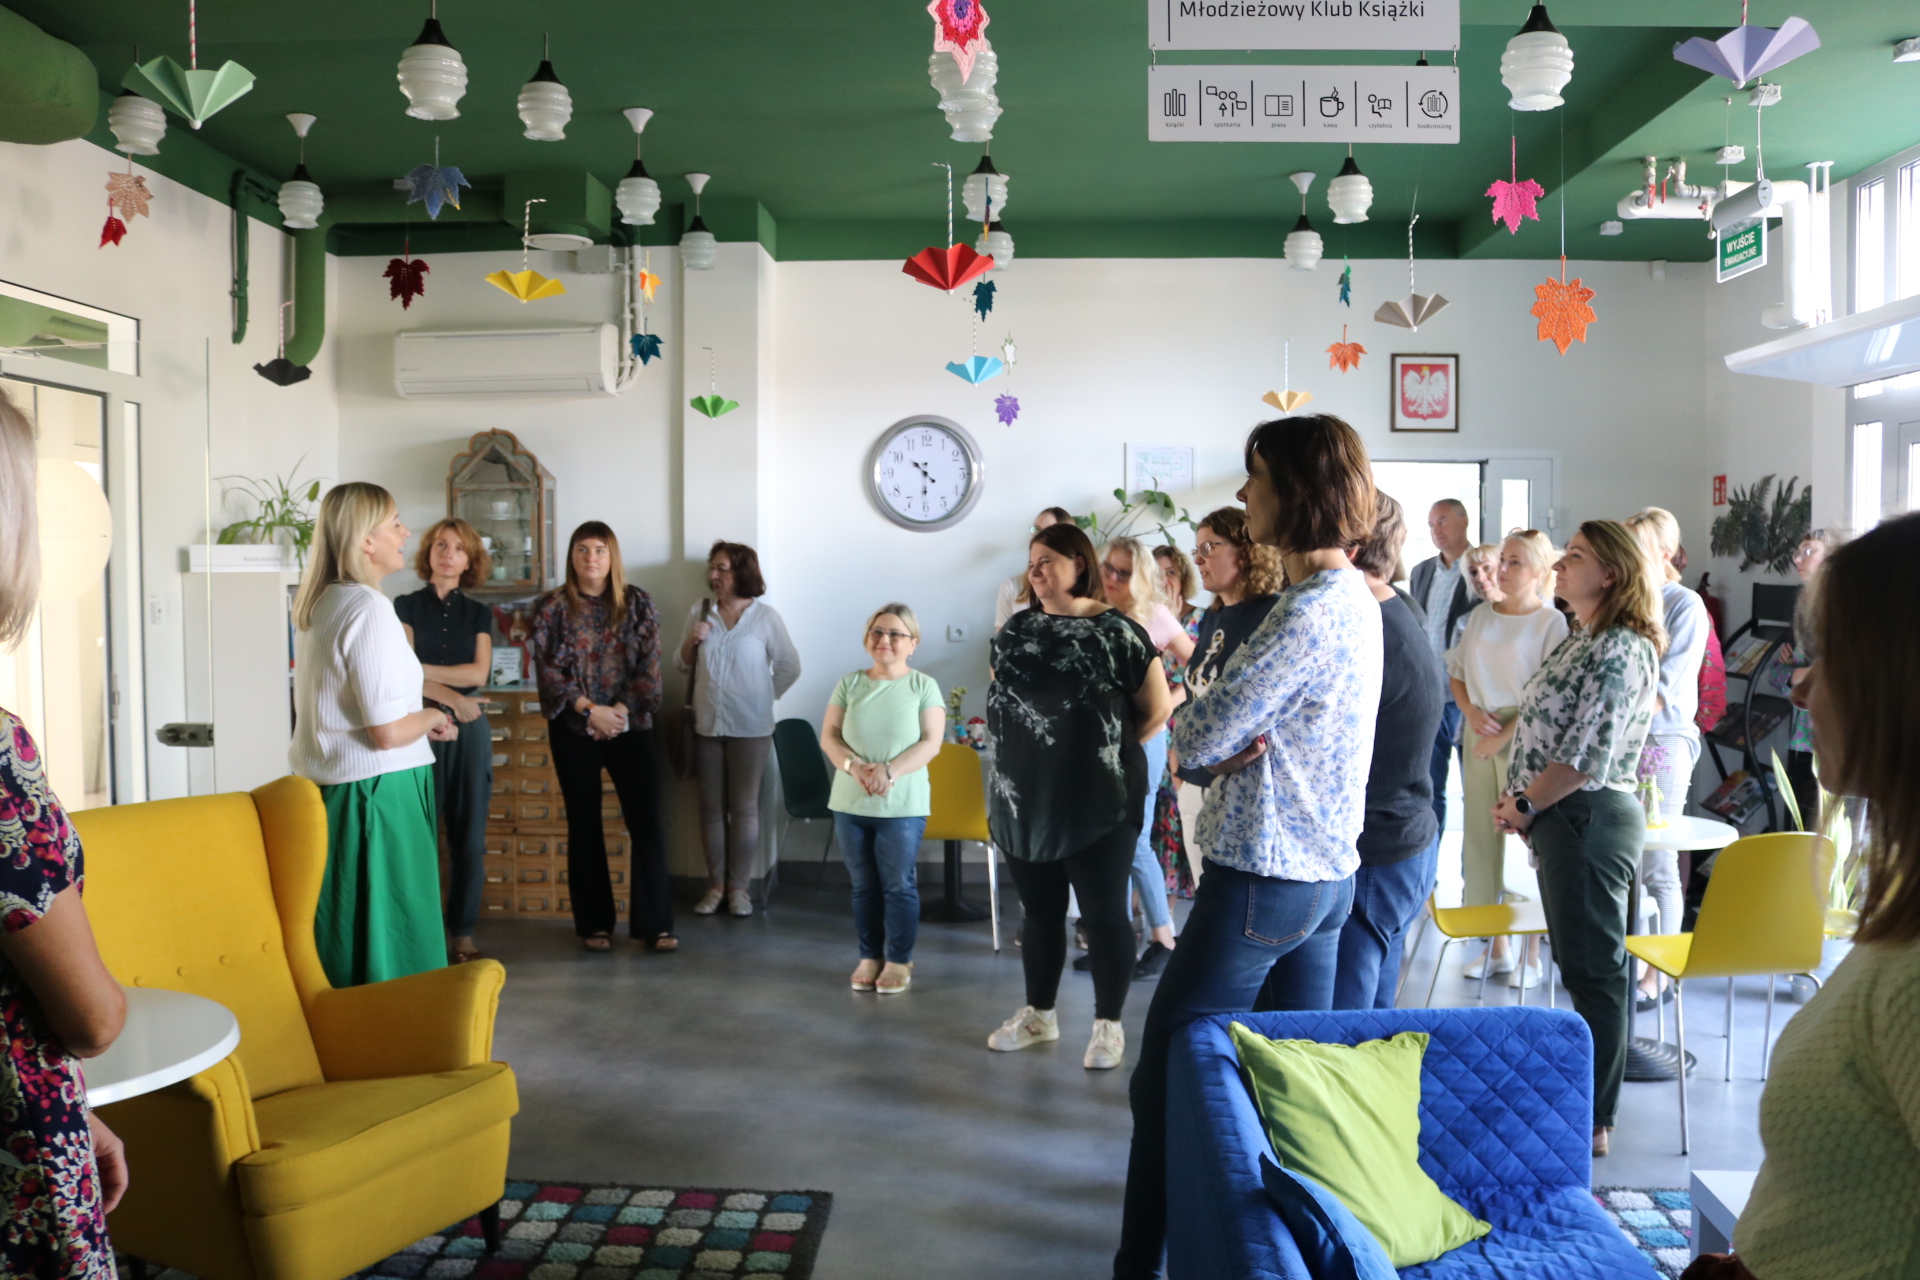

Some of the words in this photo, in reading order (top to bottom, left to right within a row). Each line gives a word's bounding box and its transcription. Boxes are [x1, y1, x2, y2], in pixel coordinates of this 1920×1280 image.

[1180, 0, 1305, 21] Młodzieżowy
[1311, 0, 1352, 17] Klub
[1359, 0, 1425, 21] Książki
[1165, 121, 1185, 129] książki
[1726, 231, 1755, 254] WYJŚCIE
[1724, 246, 1757, 267] EWAKUACYJNE
[907, 439, 915, 451] 11
[922, 434, 932, 447] 12
[893, 451, 903, 463] 10
[952, 450, 960, 462] 2
[887, 467, 894, 479] 9
[893, 484, 900, 497] 8
[906, 496, 913, 509] 7
[922, 501, 929, 513] 6
[940, 496, 947, 509] 5
